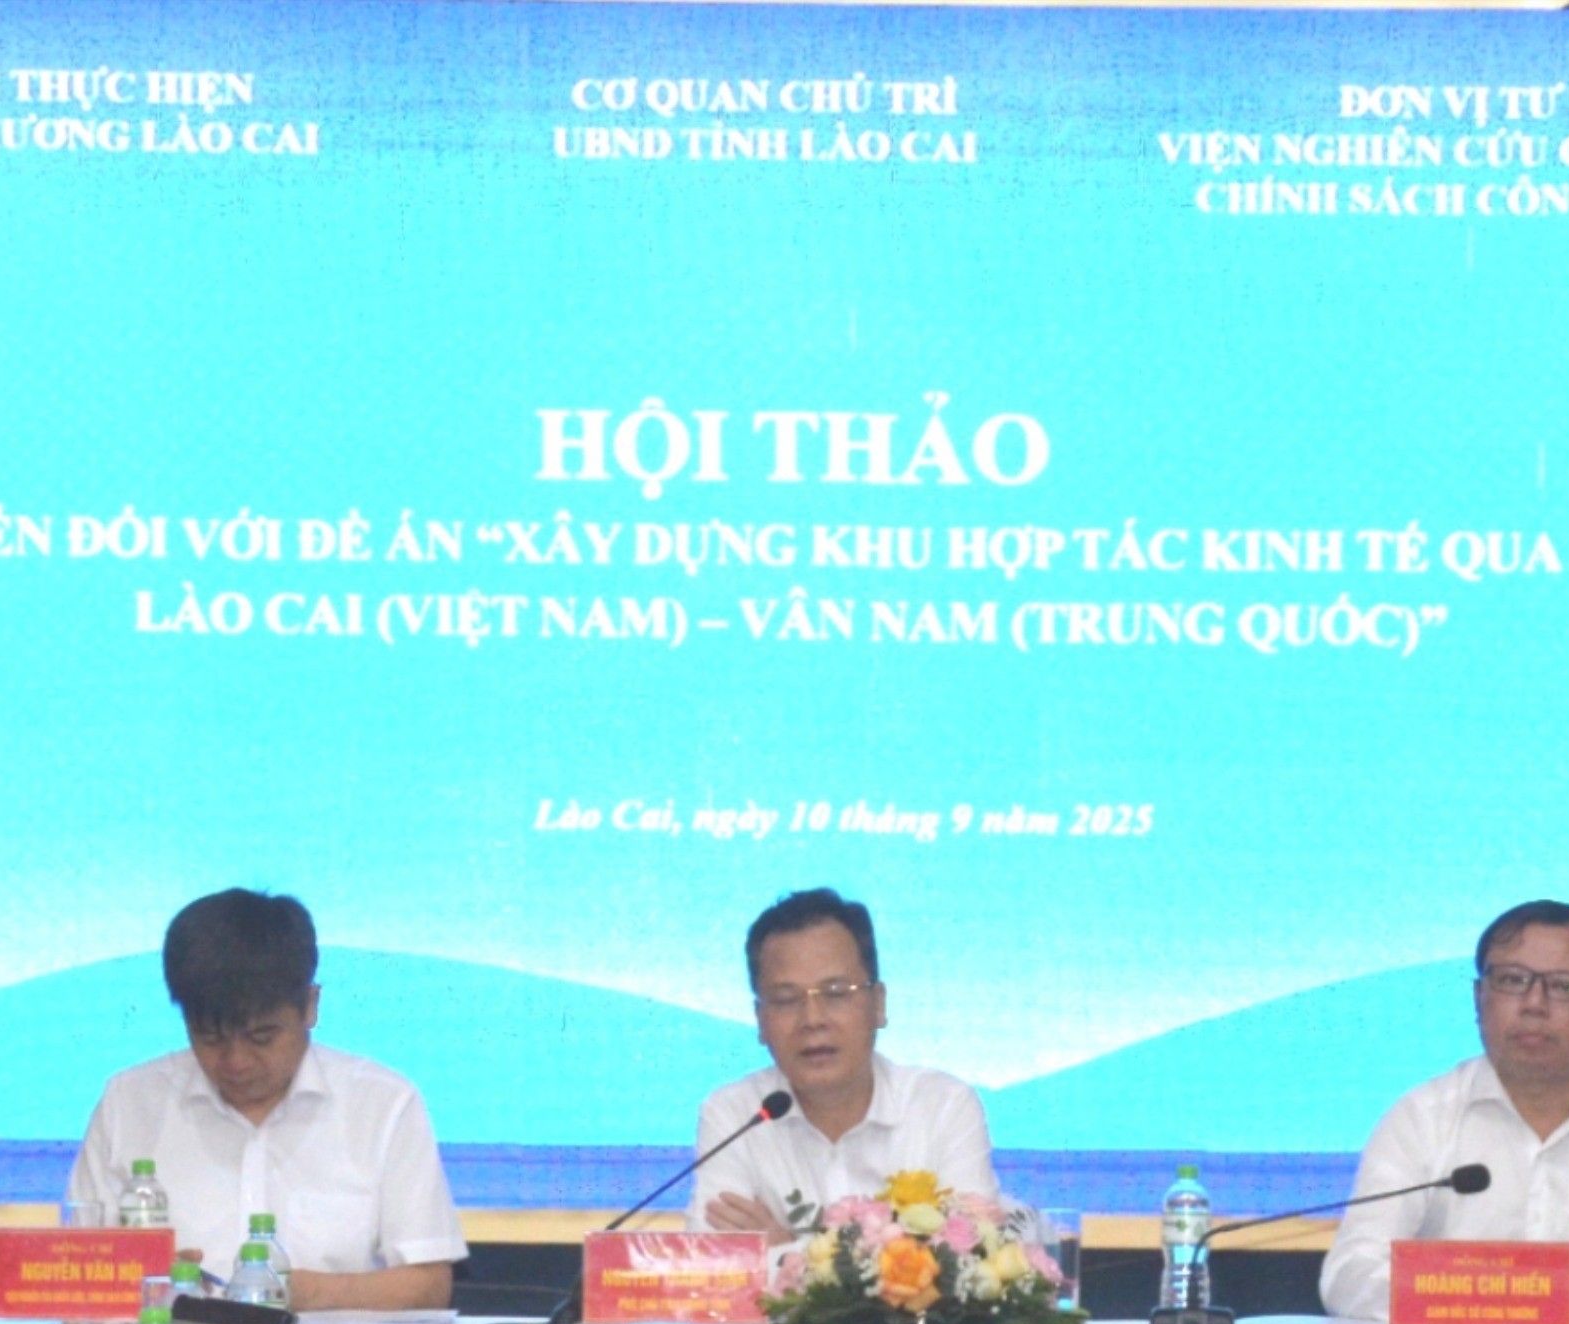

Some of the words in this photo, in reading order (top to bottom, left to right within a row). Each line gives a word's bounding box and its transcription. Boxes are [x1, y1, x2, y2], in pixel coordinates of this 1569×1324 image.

[9, 65, 137, 112] THỰC
[146, 70, 254, 114] HIỆN
[571, 76, 639, 111] CƠ
[644, 78, 770, 119] QUAN
[1340, 83, 1433, 119] ĐƠN
[1442, 85, 1490, 128] VỊ
[1498, 81, 1566, 120] TƯ
[141, 112, 234, 154] LÀO
[241, 122, 319, 155] CAI
[554, 126, 674, 160] UBND
[800, 121, 892, 162] LÀO
[899, 130, 977, 164] CAI
[1158, 129, 1262, 174] VIỆN
[1274, 129, 1443, 167] NGHIÊN
[1194, 174, 1339, 215] CHÍNH
[1348, 176, 1466, 217] SÁCH
[535, 396, 729, 501] HỘI
[752, 390, 1050, 487] THẢO
[181, 507, 282, 561] VỚI
[385, 508, 463, 563] ÁN
[634, 518, 797, 577] DỰNG
[811, 524, 932, 570] KHU
[947, 524, 1066, 581] HỢP
[1071, 517, 1189, 571] TÁC
[1202, 528, 1344, 572] KINH
[1440, 530, 1563, 582] QUA
[135, 581, 254, 635] LÀO
[263, 592, 364, 636] CAI
[376, 589, 529, 648] (VIỆT
[540, 596, 689, 647] NAM)
[739, 584, 855, 641] VÂN
[870, 600, 998, 643] NAM
[1010, 601, 1225, 652] (TRUNG
[533, 799, 603, 831] Lào
[611, 799, 682, 837] Cai,
[691, 800, 779, 841] ngày
[789, 800, 832, 832] 10
[950, 803, 974, 834] 9
[1068, 803, 1154, 836] 2025
